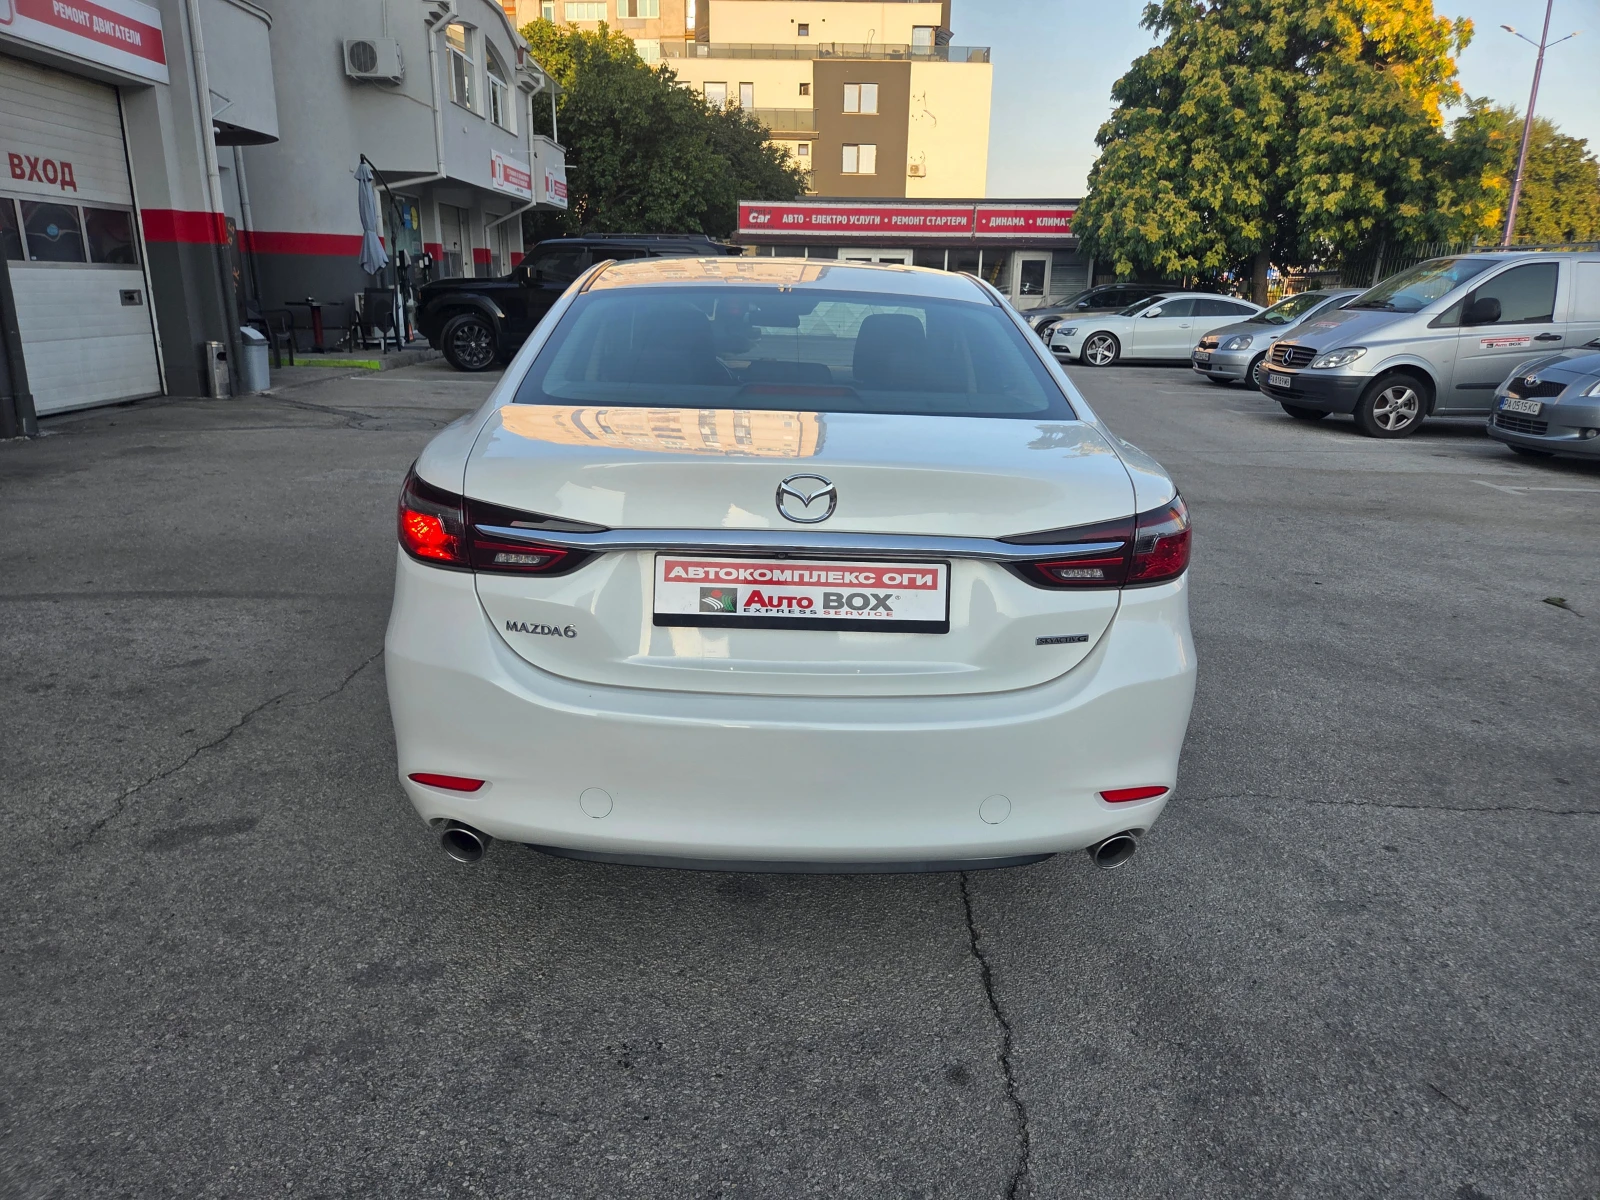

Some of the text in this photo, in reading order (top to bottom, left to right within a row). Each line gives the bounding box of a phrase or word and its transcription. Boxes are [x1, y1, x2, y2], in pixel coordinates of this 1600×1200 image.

[53, 1, 142, 46] РЕМОНТ ДВИГАТЕЛИ
[8, 152, 77, 192] ВХОД
[748, 213, 771, 223] Car
[782, 214, 804, 223] АВТО
[811, 214, 848, 225] ЕЛЕКТРО
[849, 215, 881, 225] УСЛУГИ
[892, 216, 925, 226] РЕМОНТ
[926, 216, 967, 226] СТАРТЕРИ
[989, 217, 1025, 227] ДИНАМА
[668, 566, 933, 586] АВТОКОМПЛЕКС ОГИ
[743, 607, 817, 615] EXPRESS
